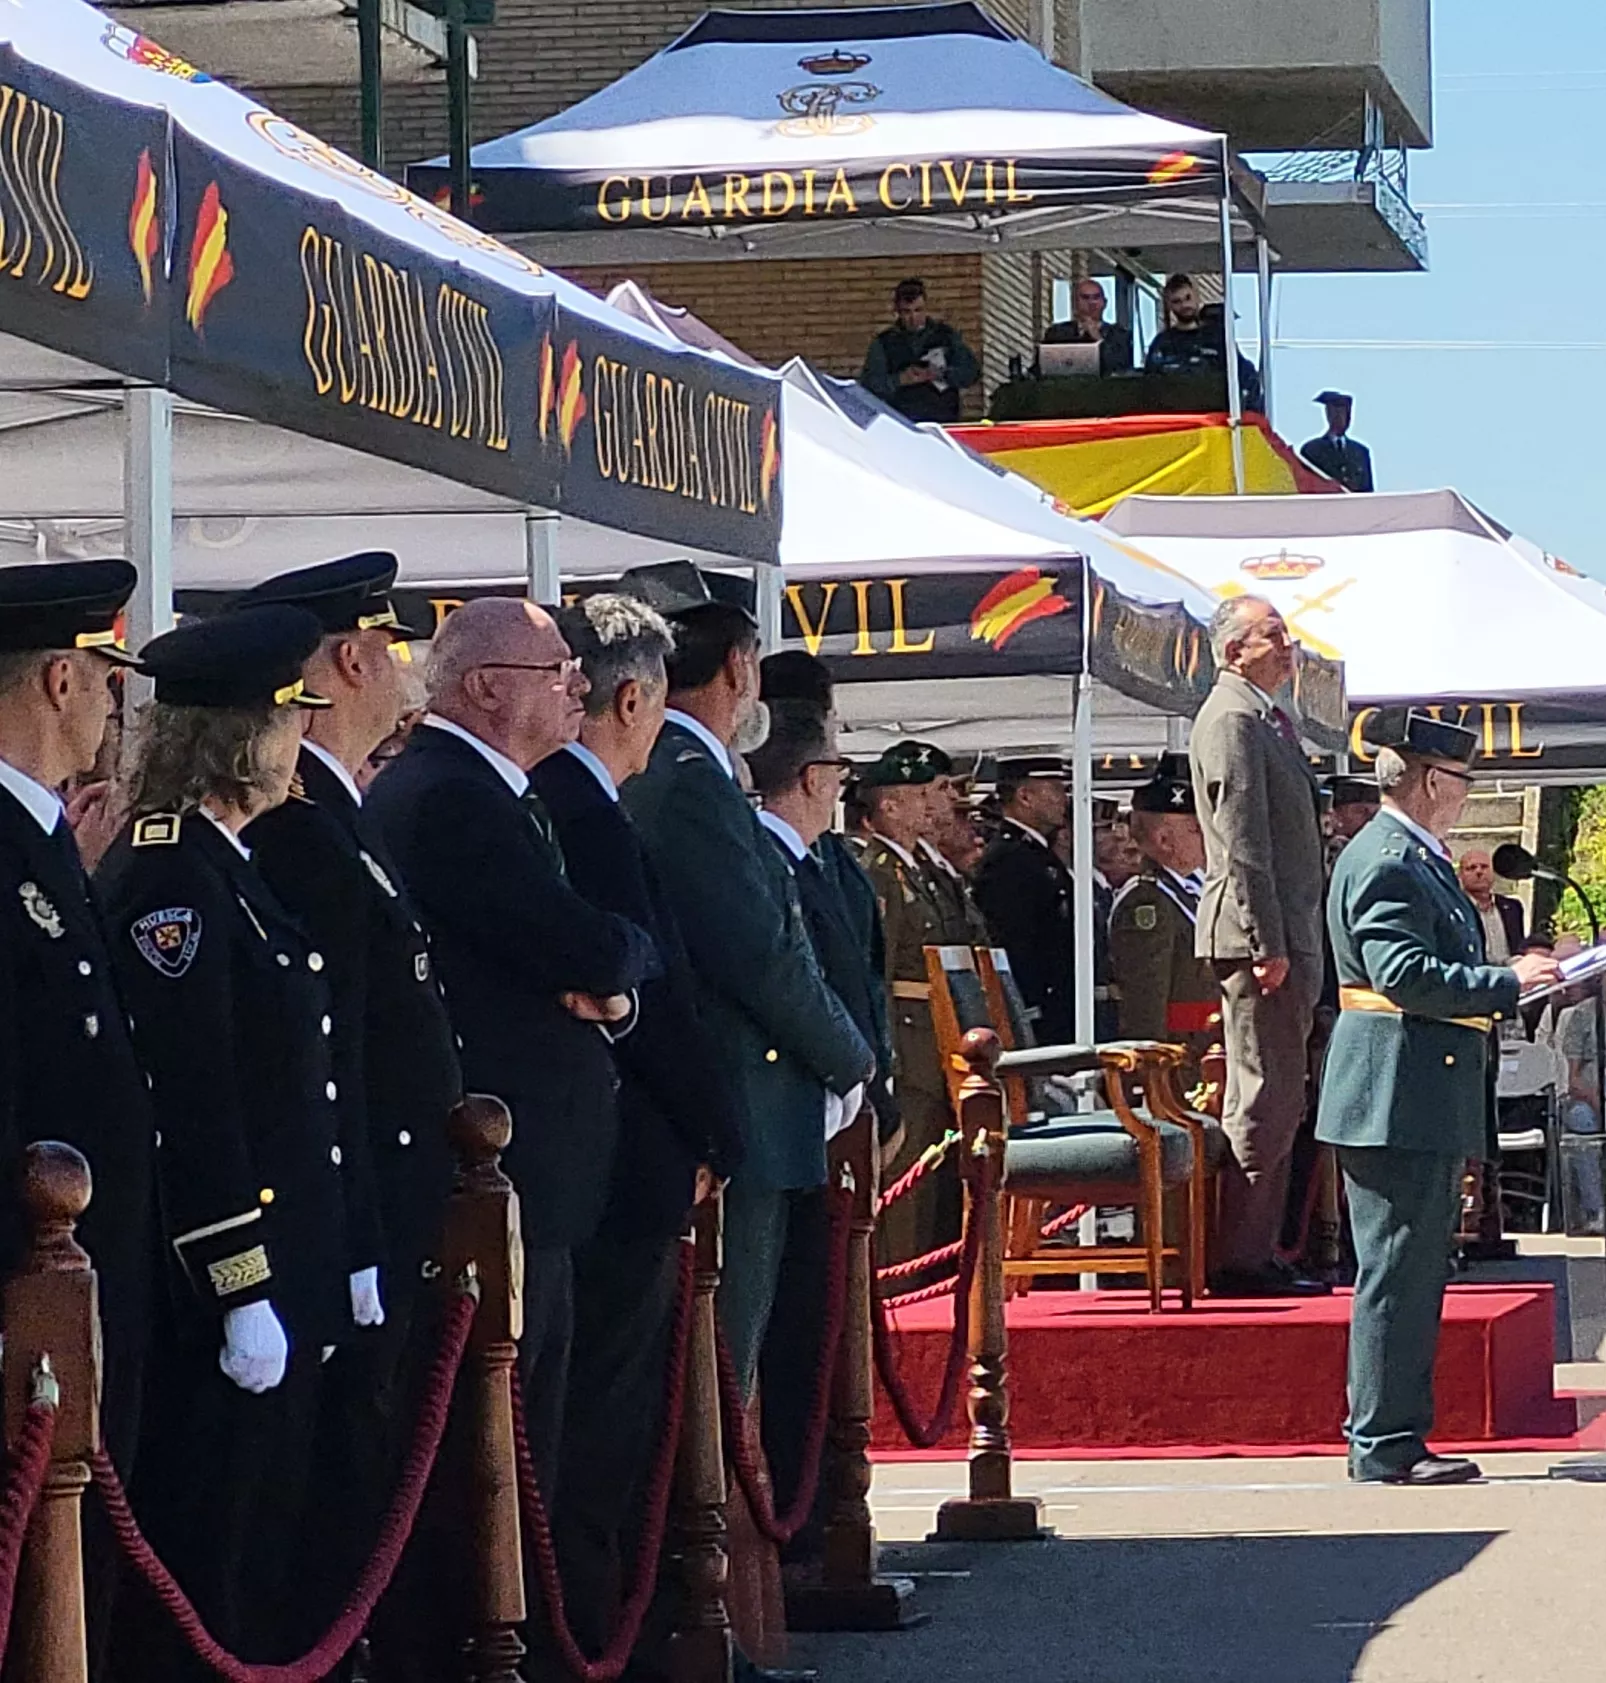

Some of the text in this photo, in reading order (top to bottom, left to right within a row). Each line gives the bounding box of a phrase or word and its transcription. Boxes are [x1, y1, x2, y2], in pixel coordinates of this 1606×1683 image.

[597, 159, 1034, 222] GUARDIA CIVIL
[300, 225, 510, 451] GUARDIA CIVIL
[594, 355, 757, 515] GUARDIA CIVIL
[784, 578, 936, 657] VIL
[1351, 702, 1545, 763] CIL
